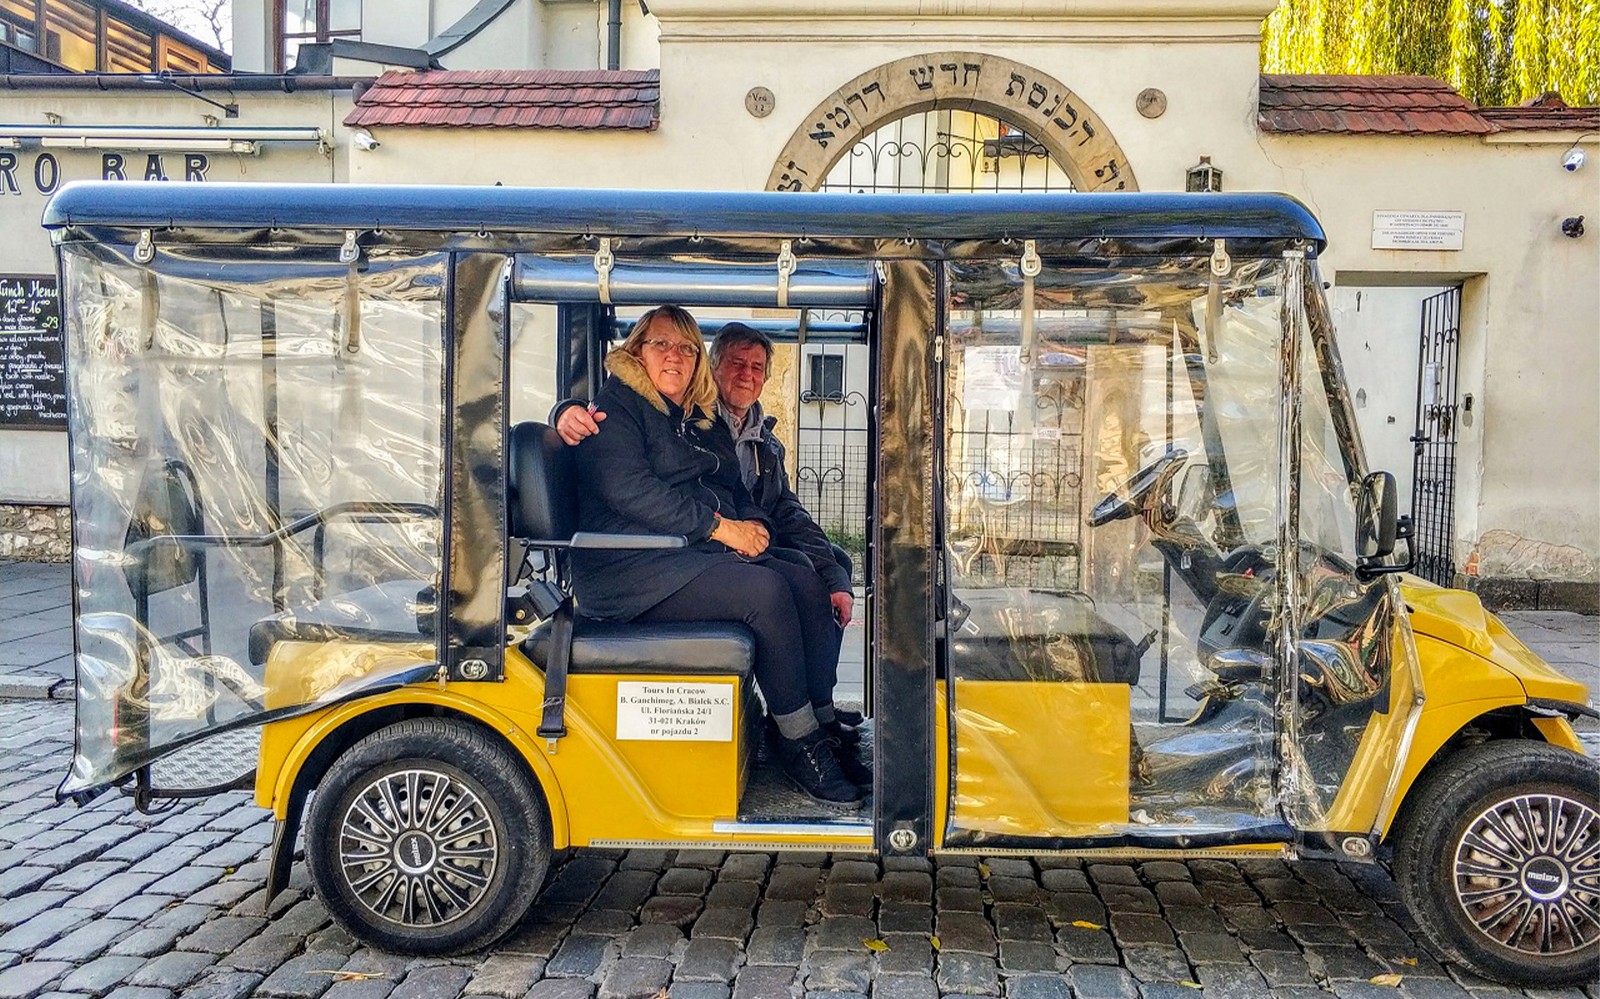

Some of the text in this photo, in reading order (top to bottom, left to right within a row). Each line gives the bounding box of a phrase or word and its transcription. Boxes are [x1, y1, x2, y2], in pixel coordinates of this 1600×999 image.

[909, 62, 981, 90] חדש
[101, 153, 210, 182] BAR
[28, 280, 58, 298] Menu
[642, 686, 664, 694] Tours
[677, 687, 706, 695] Cracow
[620, 696, 628, 704] B.
[714, 698, 730, 706] S.C.
[697, 707, 712, 715] 24/1
[648, 717, 706, 725] 31-021 Kraków
[661, 728, 692, 736] pojazdu
[1527, 871, 1559, 882] melex
